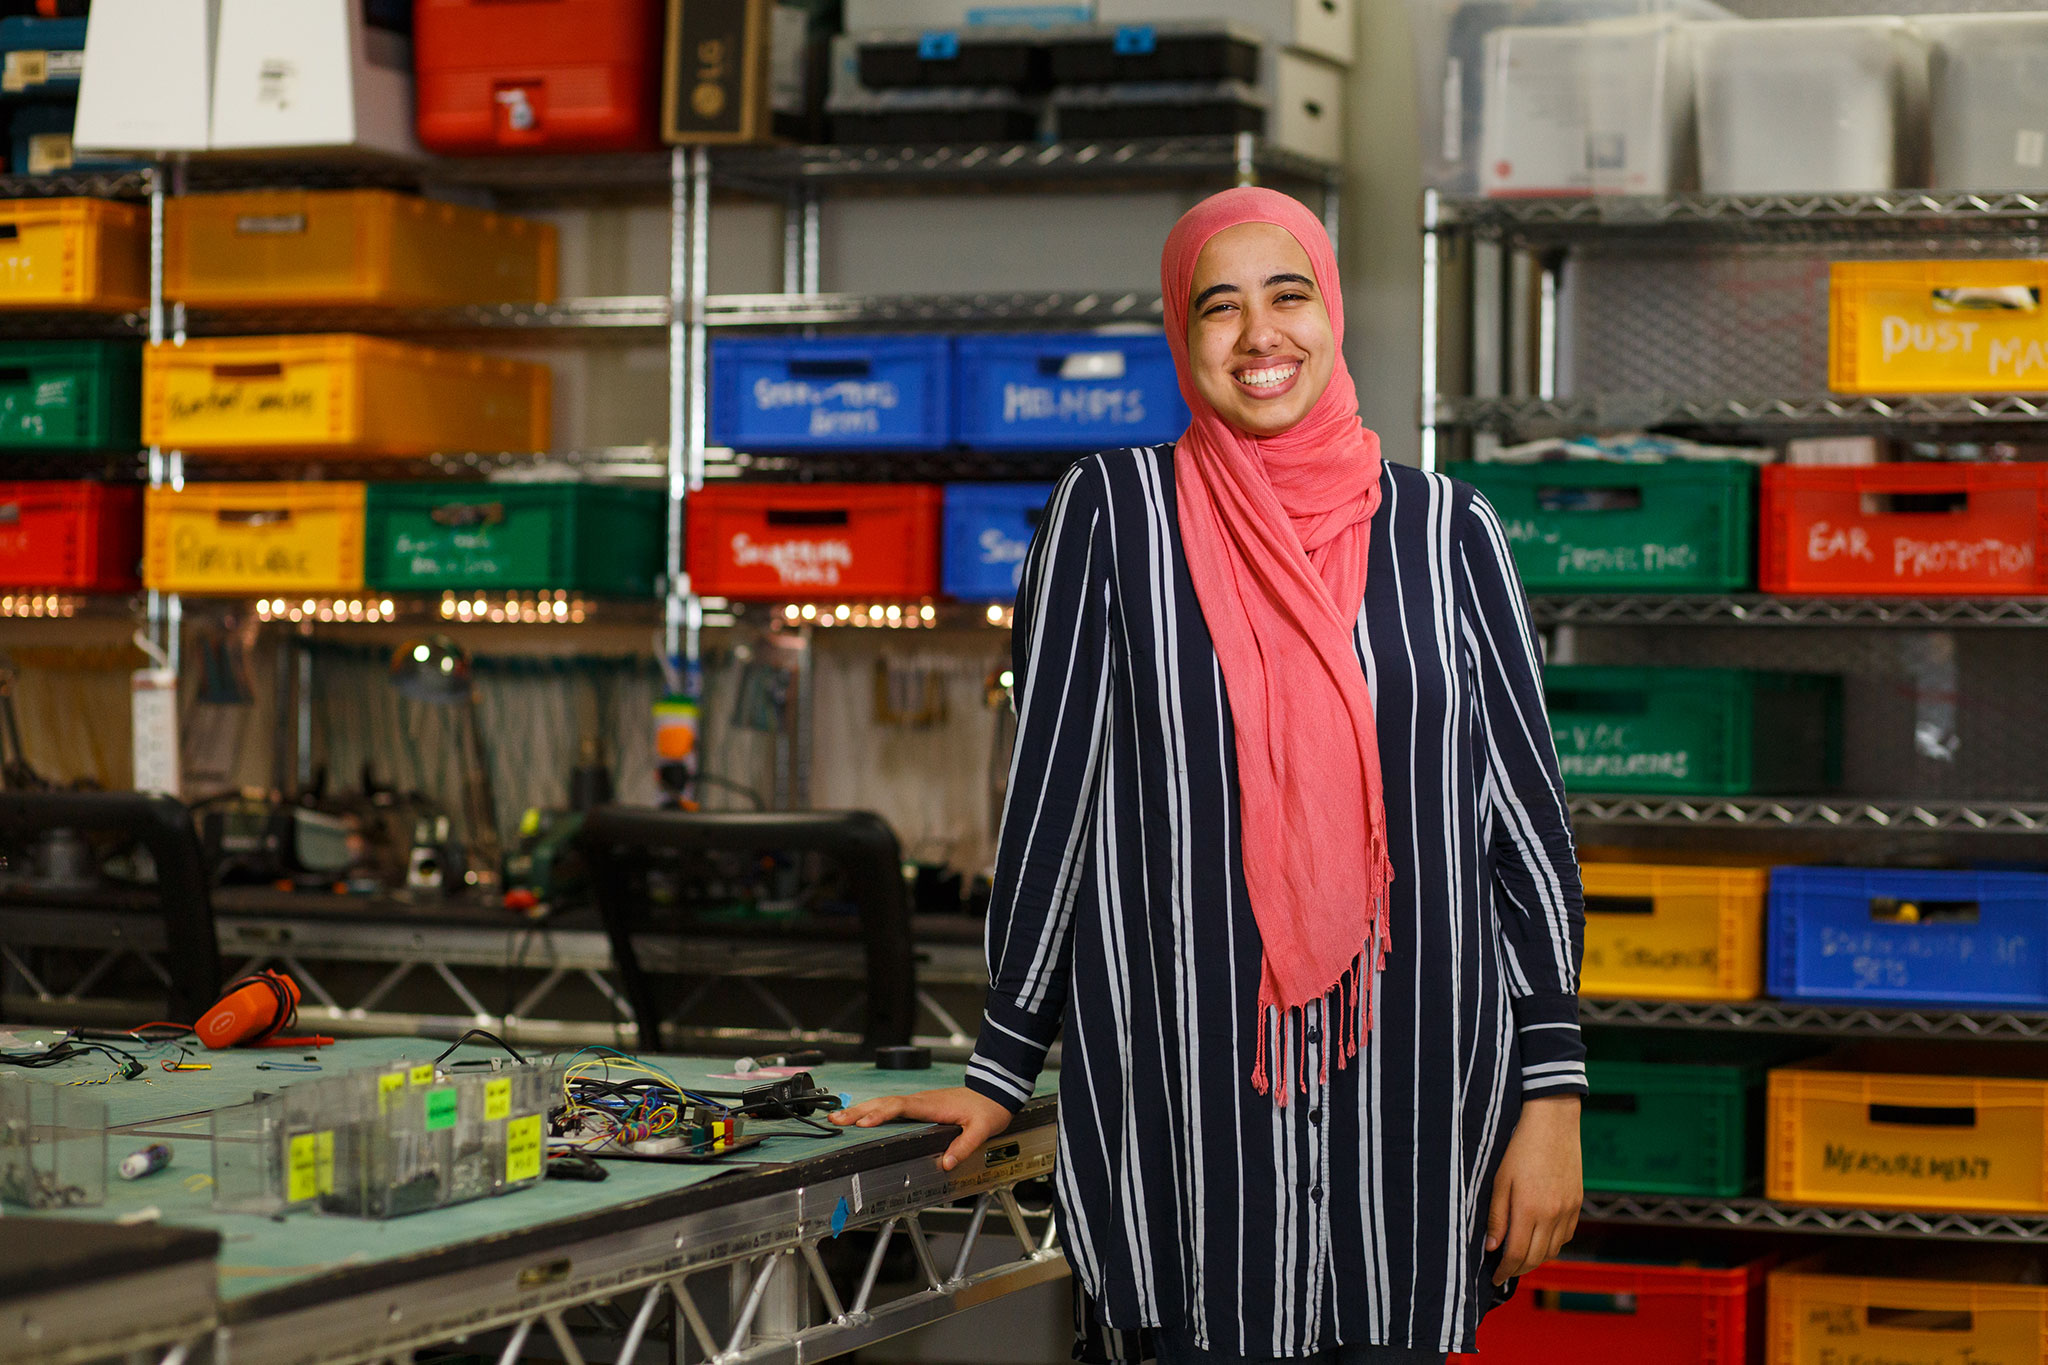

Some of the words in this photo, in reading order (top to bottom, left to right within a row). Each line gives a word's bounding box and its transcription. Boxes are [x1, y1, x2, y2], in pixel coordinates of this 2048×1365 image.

[1881, 315, 1980, 363] DUST
[1989, 336, 2048, 378] MA
[1808, 521, 1875, 562] EAR
[1893, 537, 2035, 577] PROTECTION
[1823, 1142, 1992, 1183] MEASUREMENT
